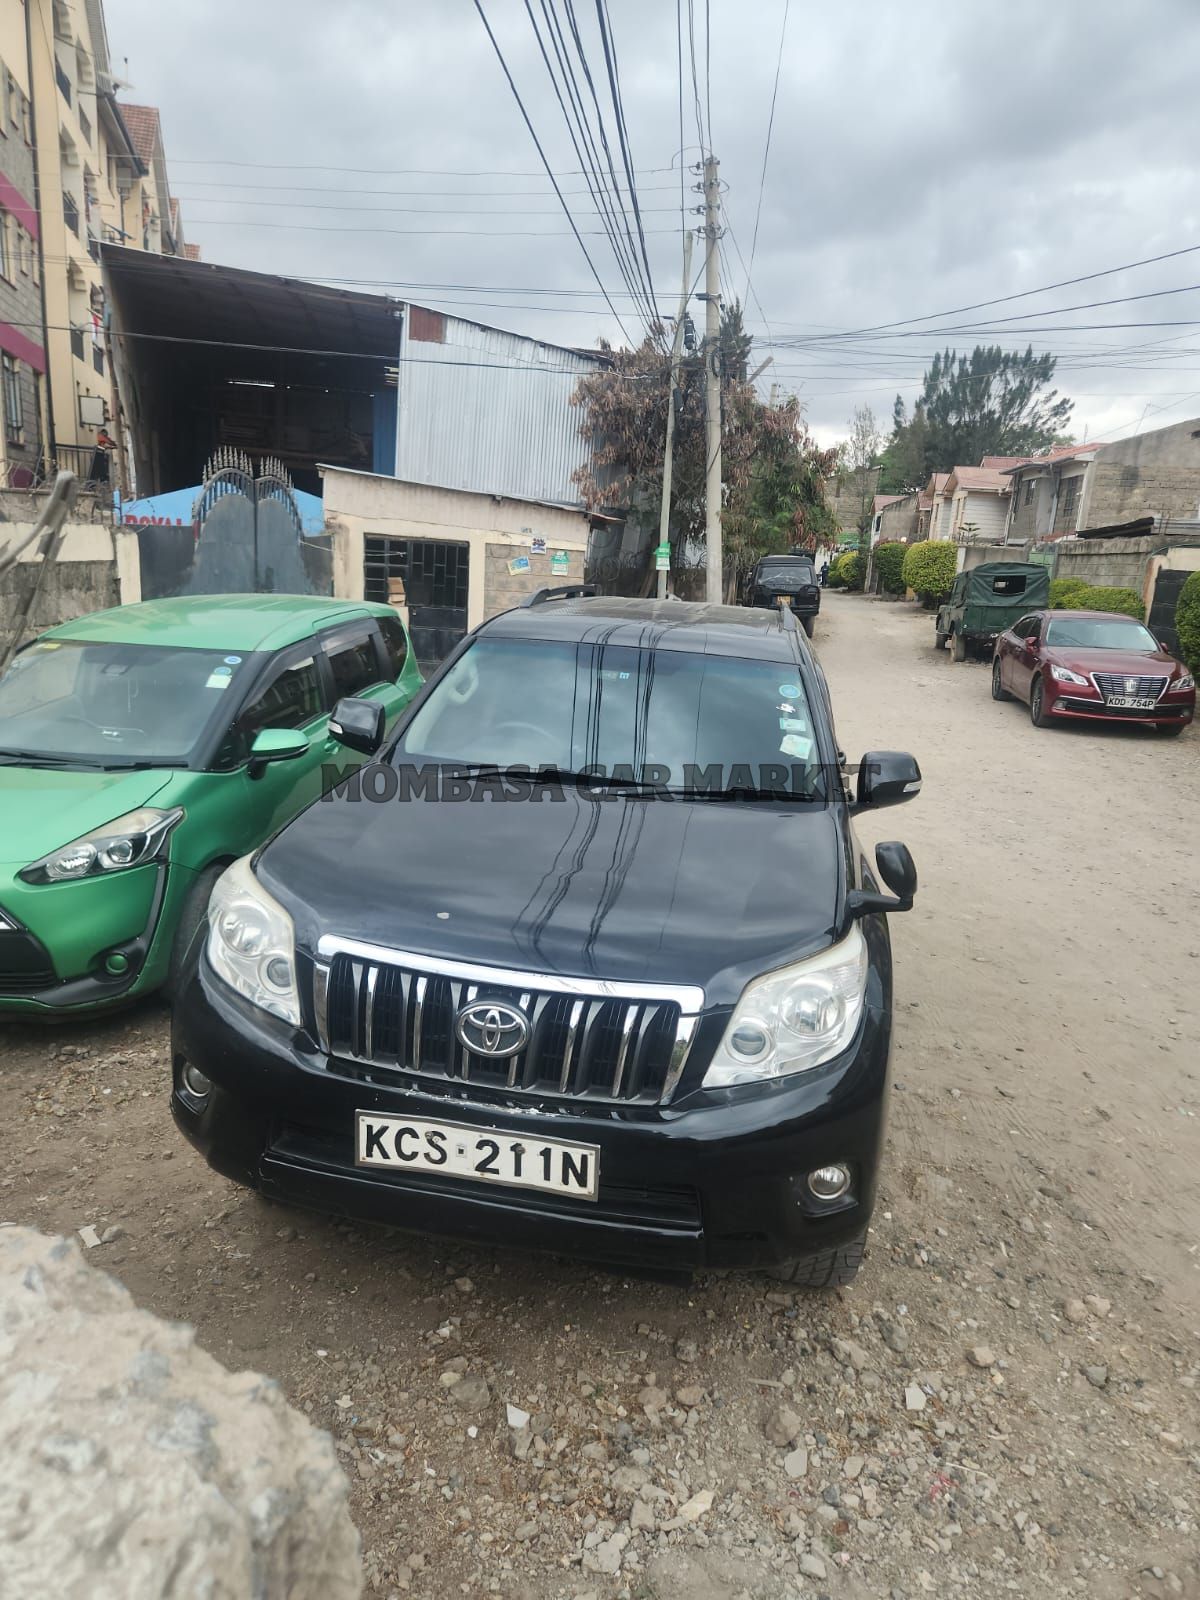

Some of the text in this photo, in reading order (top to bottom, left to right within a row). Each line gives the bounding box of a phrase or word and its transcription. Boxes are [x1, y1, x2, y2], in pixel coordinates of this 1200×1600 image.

[1130, 699, 1154, 707] 754P
[365, 1124, 588, 1188] KCS 211N
